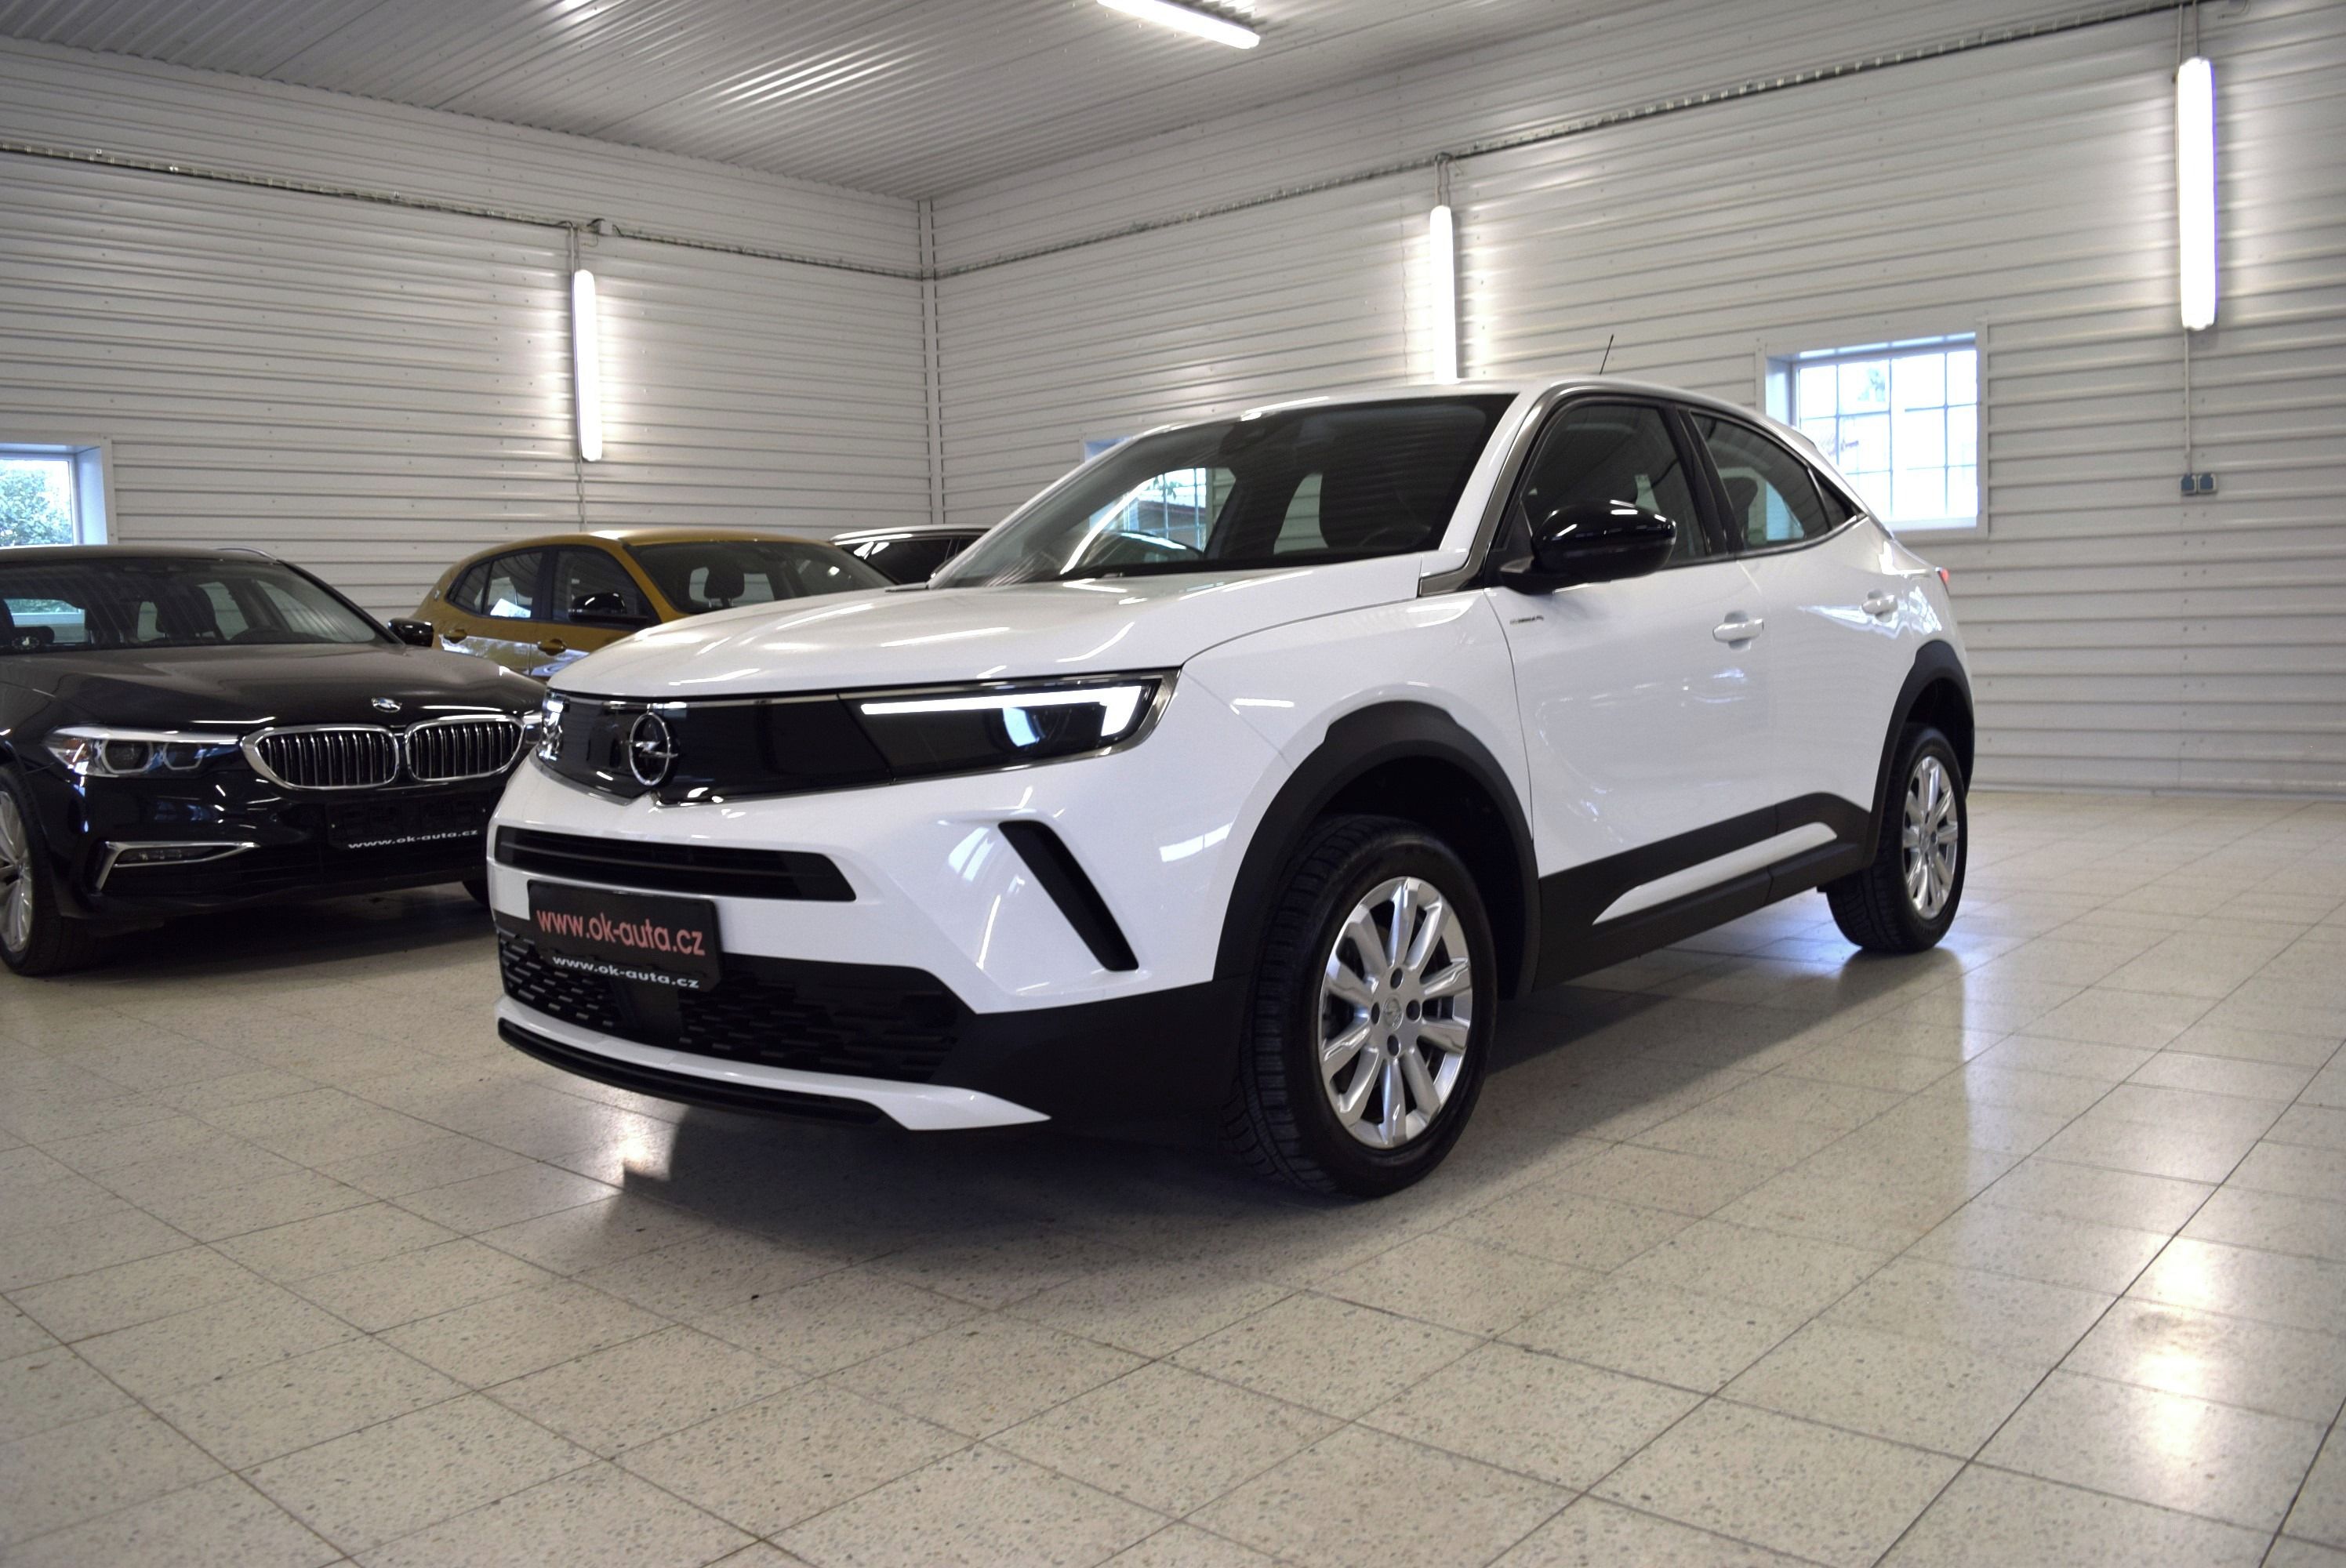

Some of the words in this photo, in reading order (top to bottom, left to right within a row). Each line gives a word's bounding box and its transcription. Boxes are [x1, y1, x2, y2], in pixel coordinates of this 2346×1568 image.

[348, 829, 478, 848] www.ok-auta.cz
[537, 909, 705, 956] www.ok-auta.cz
[552, 956, 699, 989] www.ok-auta.cz
